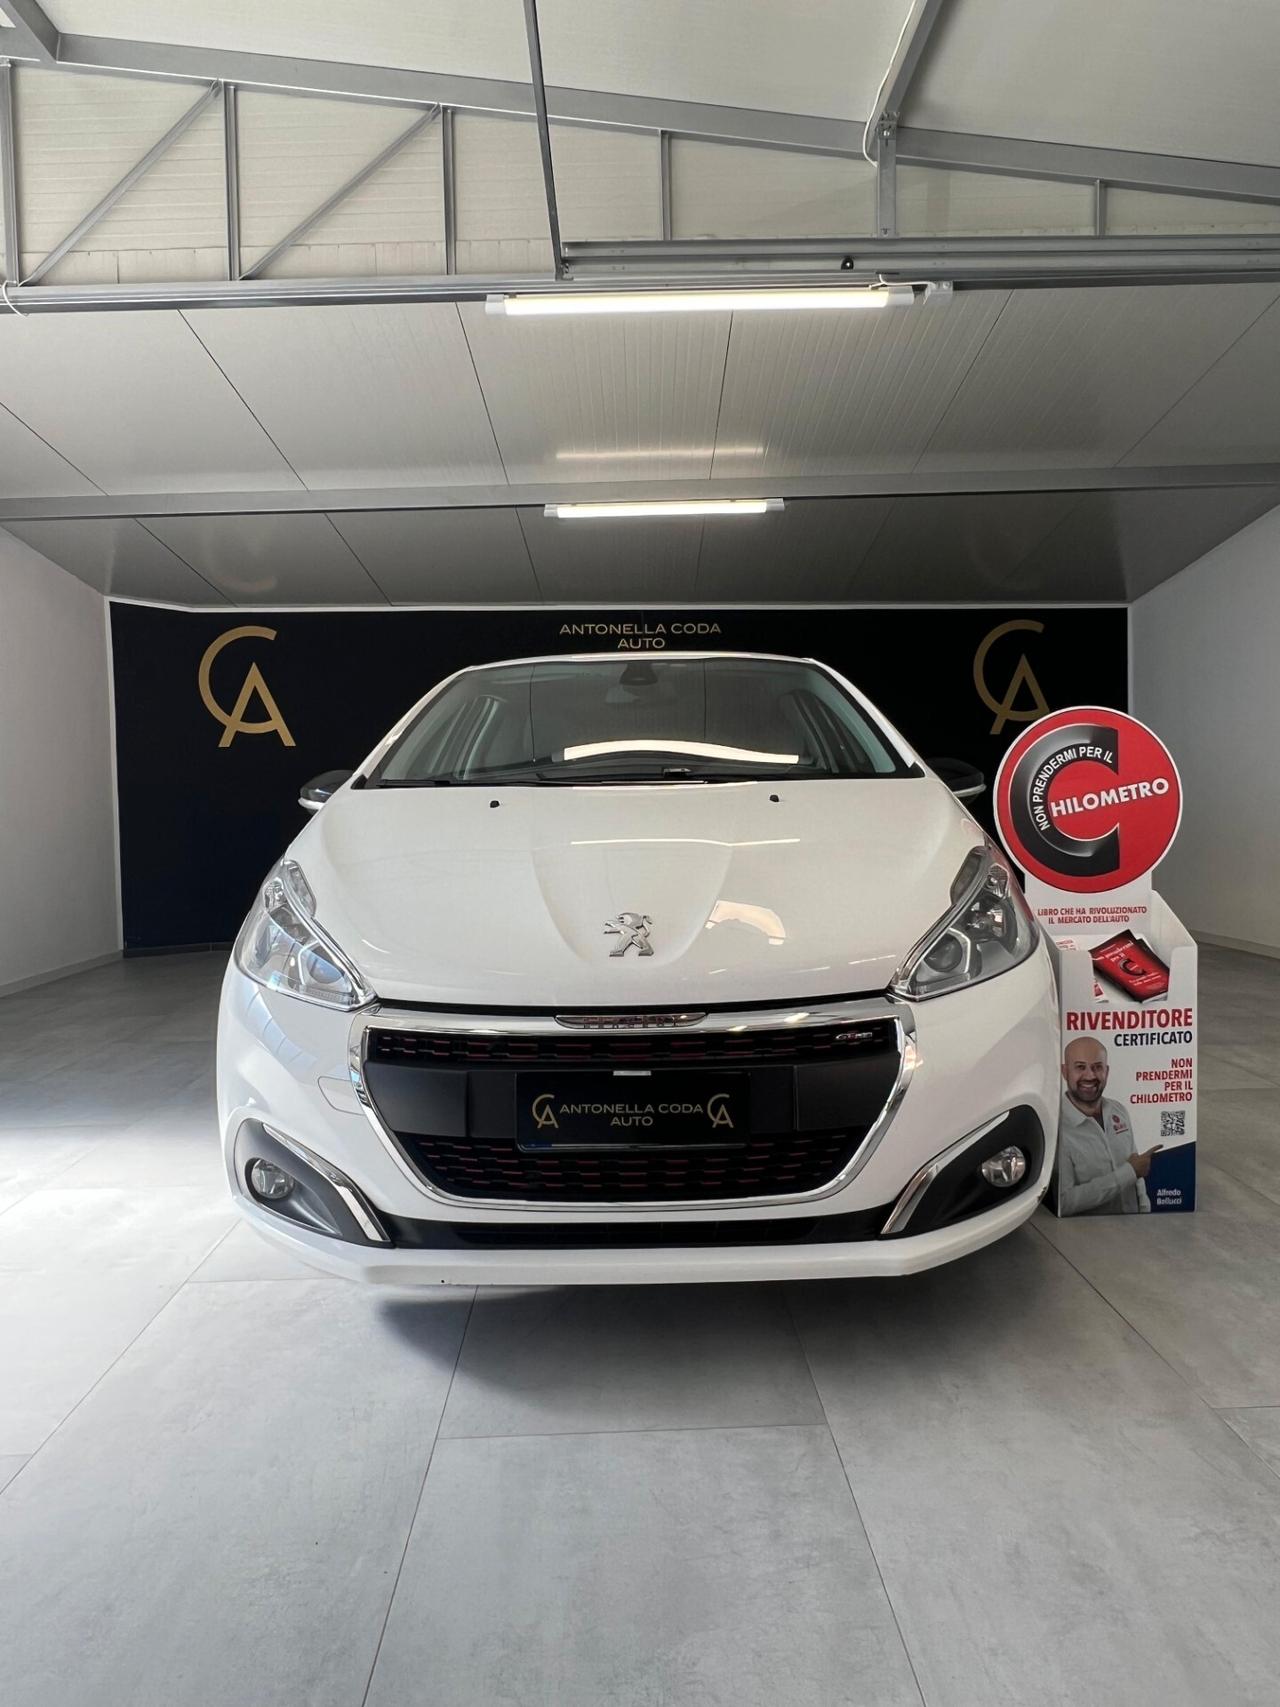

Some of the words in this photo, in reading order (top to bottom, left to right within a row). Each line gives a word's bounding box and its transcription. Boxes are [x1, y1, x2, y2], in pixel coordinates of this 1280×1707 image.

[560, 624, 667, 634] ANTONELLA
[671, 623, 722, 634] CODA
[618, 638, 665, 649] AUTO
[1079, 746, 1102, 758] PER
[1103, 750, 1113, 763] IL
[1033, 748, 1077, 803] PRENDERMI
[1033, 805, 1050, 831] NON
[1038, 908, 1059, 916] LIBRO
[1060, 908, 1074, 916] CHE
[1075, 907, 1086, 915] HA
[1089, 906, 1147, 915] RIVOLUZIONATO
[1058, 916, 1091, 924] MERCATO
[1093, 915, 1129, 923] DELL'AUTO
[1066, 1008, 1193, 1031] RIVENDITORE
[1114, 1031, 1193, 1047] CERTIFICATO
[1171, 1058, 1193, 1068] NON
[1136, 1070, 1193, 1081] PRENDERMI
[1164, 1081, 1182, 1091] PER
[1185, 1081, 1193, 1090] IL
[1130, 1092, 1193, 1104] CHILOMETRO
[560, 1104, 655, 1114] ANTONELLA
[658, 1104, 704, 1114] CODA
[610, 1116, 653, 1126] AUTO
